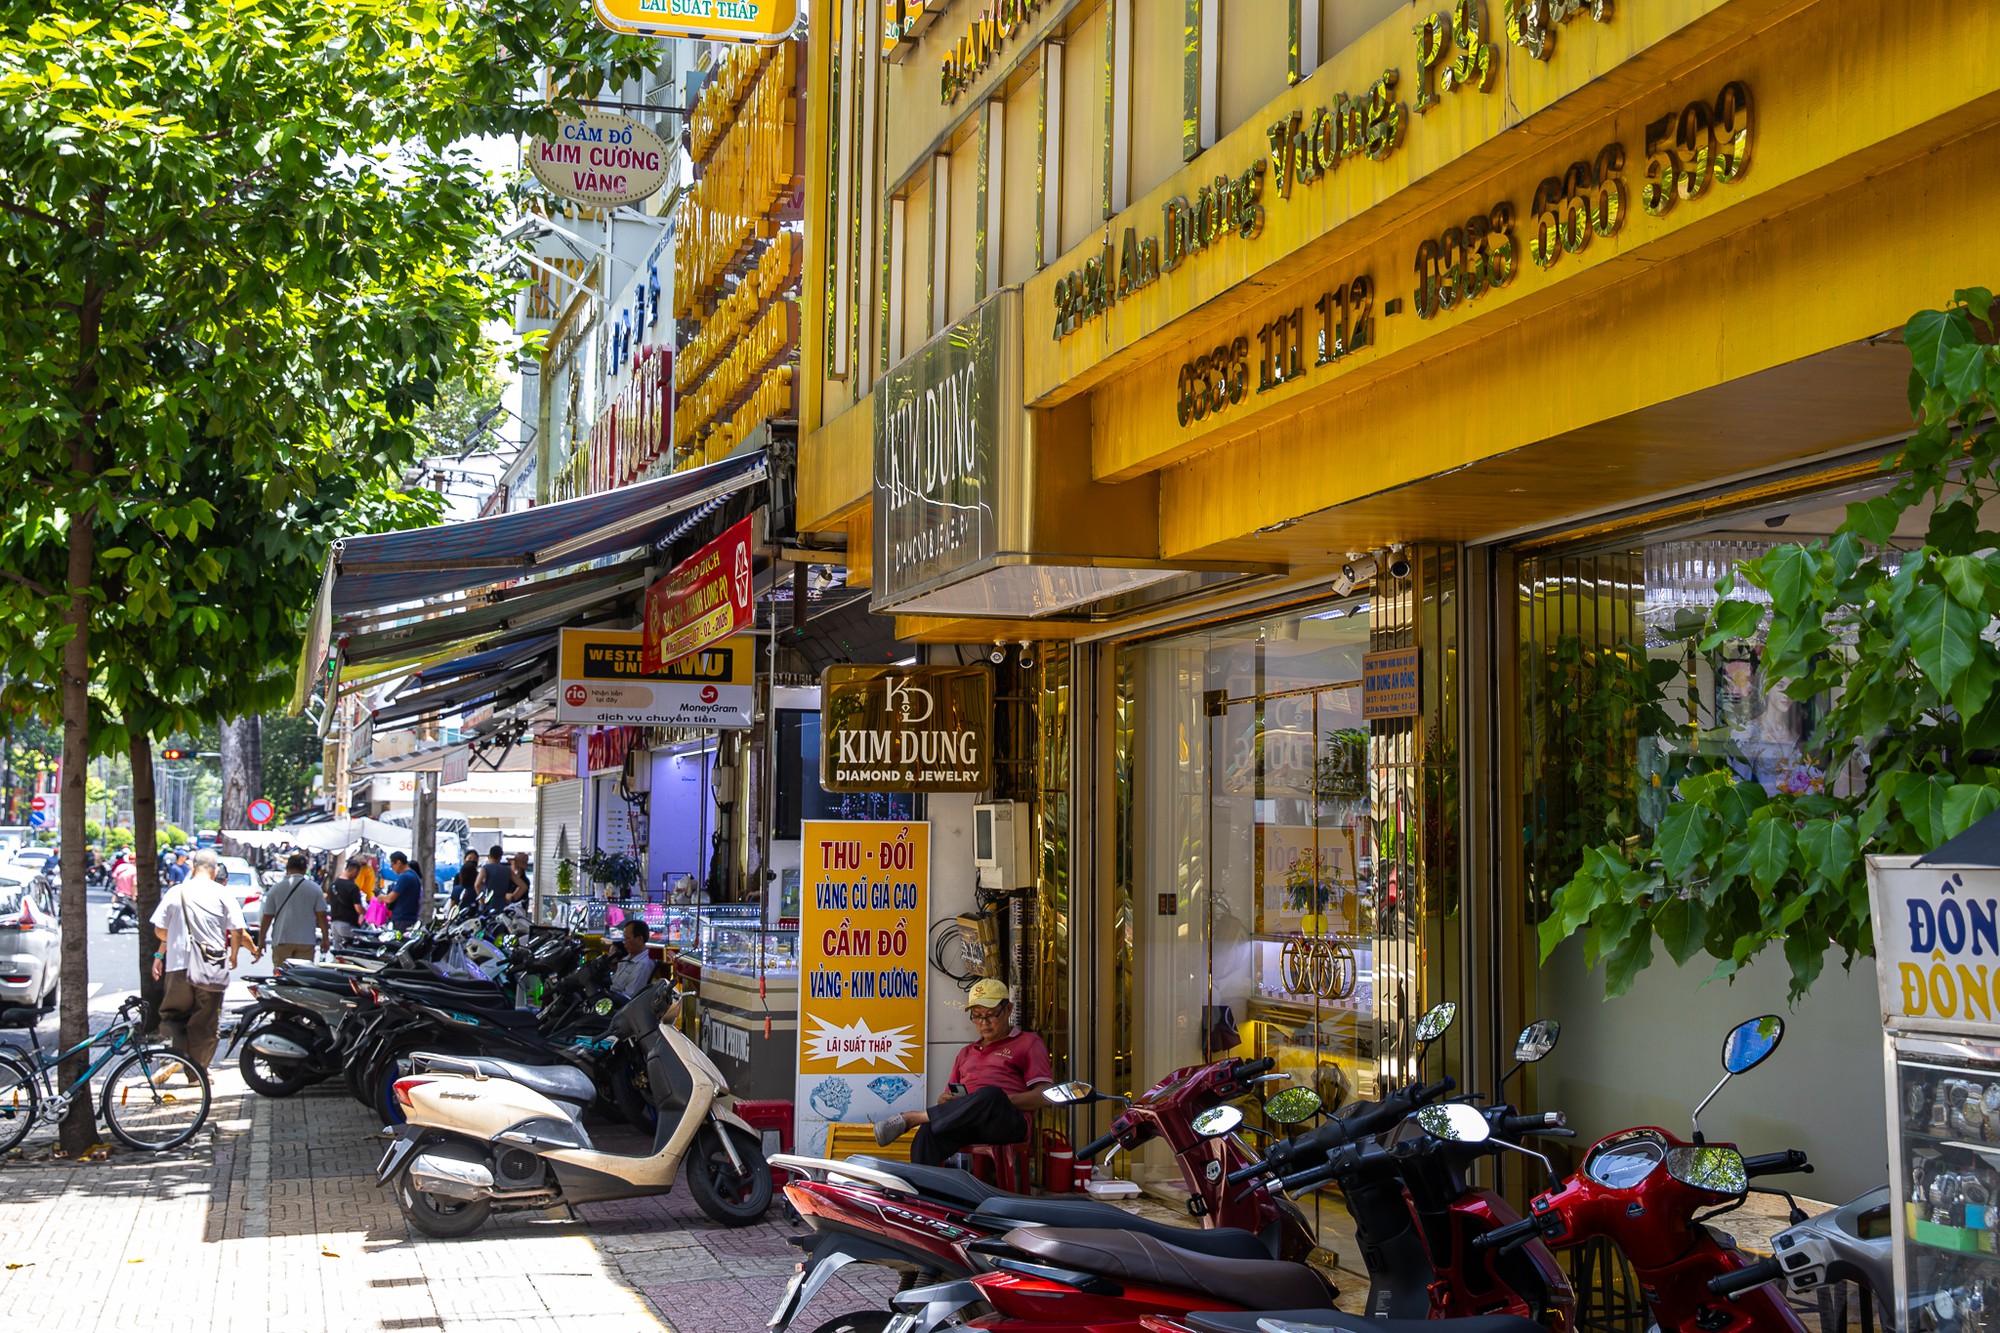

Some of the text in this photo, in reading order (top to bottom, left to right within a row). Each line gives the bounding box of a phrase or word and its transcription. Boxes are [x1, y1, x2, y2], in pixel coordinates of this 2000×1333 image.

[564, 119, 633, 146] CẦM ĐỒ
[541, 142, 660, 172] KIM CƯƠNG
[573, 167, 628, 195] VÀNG
[1116, 227, 1159, 301] An
[1161, 158, 1267, 273] Dương
[1256, 307, 1306, 394] 111
[1314, 275, 1375, 368] 112
[1530, 142, 1625, 268] 666
[1642, 80, 1754, 216] 599
[890, 397, 921, 511] KIM
[926, 361, 976, 494] DUNG
[700, 550, 720, 576] DỊCH
[704, 580, 719, 610] LONG
[693, 626, 700, 644] 07
[703, 621, 711, 638] 02
[613, 662, 668, 675] UNIN
[1366, 676, 1375, 692] KIM
[1377, 674, 1390, 690] DUNG
[1392, 673, 1398, 689] AN
[566, 686, 586, 700] ria
[597, 713, 624, 722] dịch
[694, 715, 716, 723] tiền
[679, 703, 738, 713] MoneyGram
[838, 730, 977, 764] KIM DUNG
[836, 770, 980, 782] DIAMOND & JEWELRY
[820, 841, 861, 870] THU
[880, 826, 915, 870] ĐỔI
[816, 875, 917, 910] VÀNG CŨ GIÁ CAO
[822, 917, 908, 957] CẦM ĐỒ
[810, 964, 842, 999] VÀNG
[851, 970, 875, 999] KIM
[878, 966, 918, 1000] CƯƠNG
[711, 1021, 725, 1053] KIM
[826, 1034, 893, 1053] LÃI SUẤT THẤP
